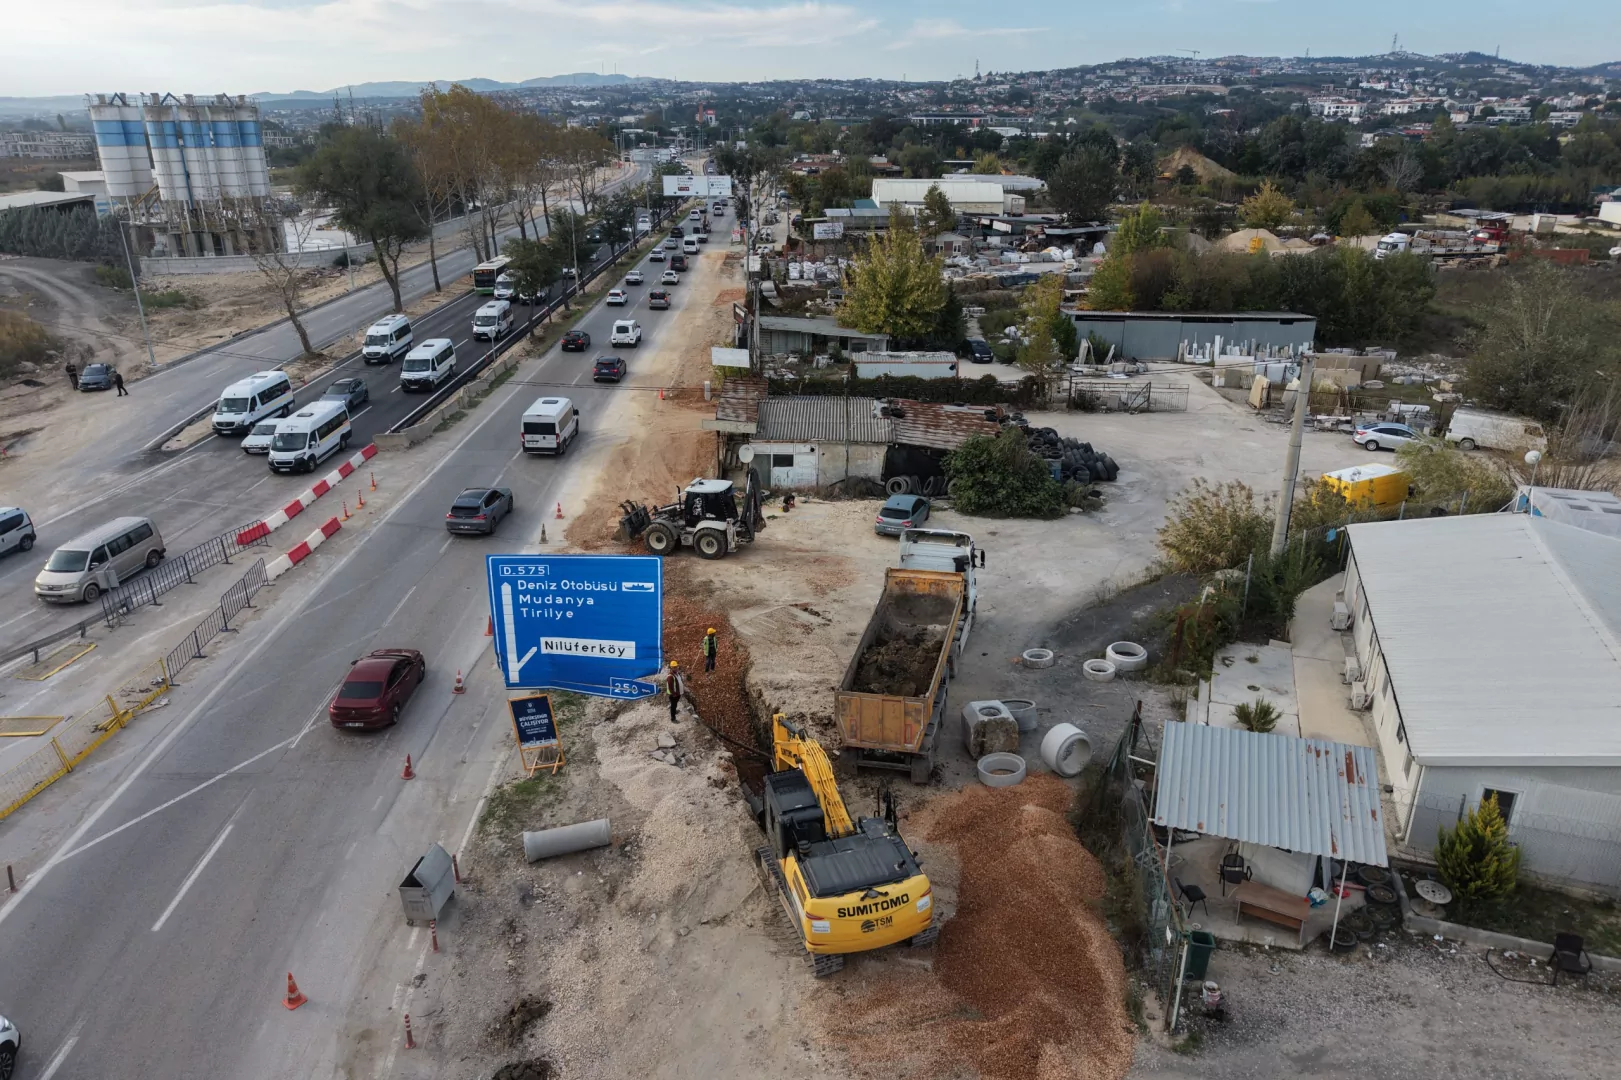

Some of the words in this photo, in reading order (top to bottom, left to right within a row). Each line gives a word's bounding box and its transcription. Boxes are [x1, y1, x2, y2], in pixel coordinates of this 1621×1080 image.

[517, 579, 558, 591] Deniz
[560, 580, 618, 592] Otobüsü
[519, 594, 595, 607] Mudanya
[520, 607, 574, 620] Tirilye
[544, 640, 626, 657] Nilüferköy
[614, 682, 639, 695] 250
[837, 893, 910, 918] SUMITOMO
[874, 915, 893, 927] TSM
